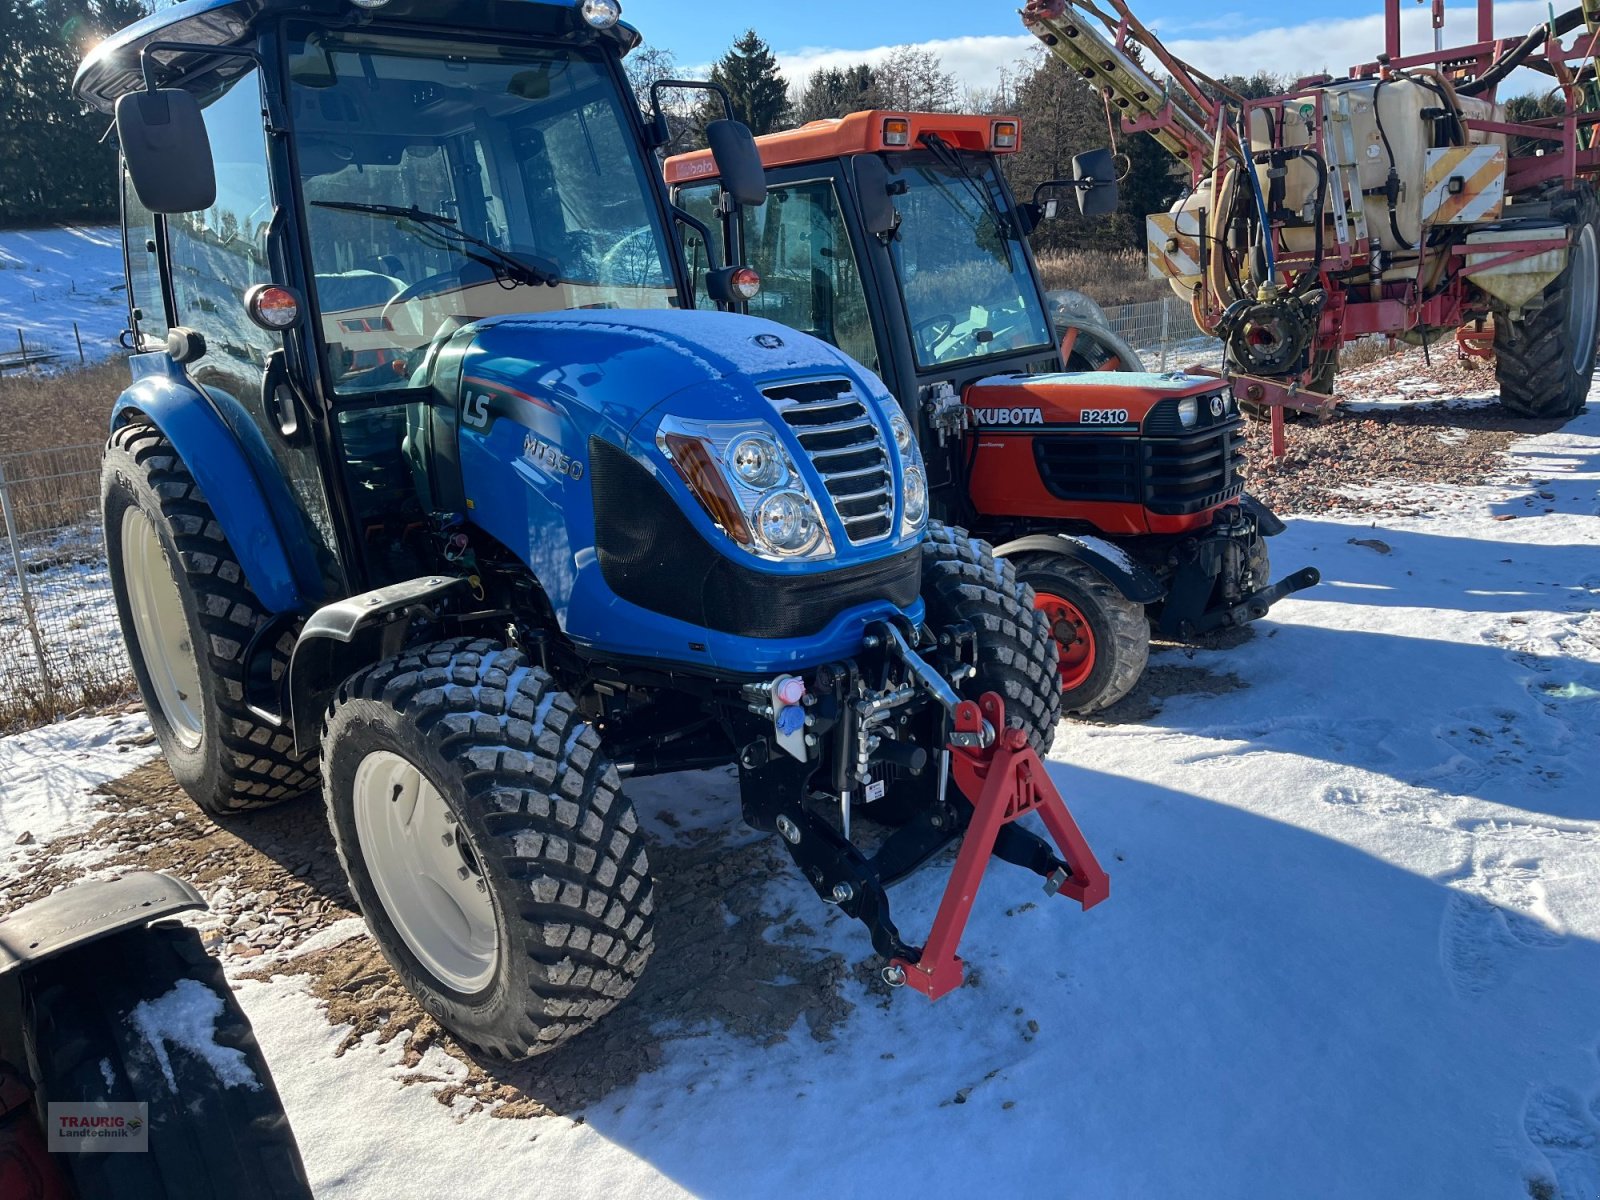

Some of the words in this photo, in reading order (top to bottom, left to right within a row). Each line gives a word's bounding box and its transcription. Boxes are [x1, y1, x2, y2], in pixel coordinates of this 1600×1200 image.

[678, 159, 713, 177] bota
[462, 391, 490, 428] LS
[974, 408, 1043, 424] KUBOTA
[1080, 409, 1128, 424] B2410
